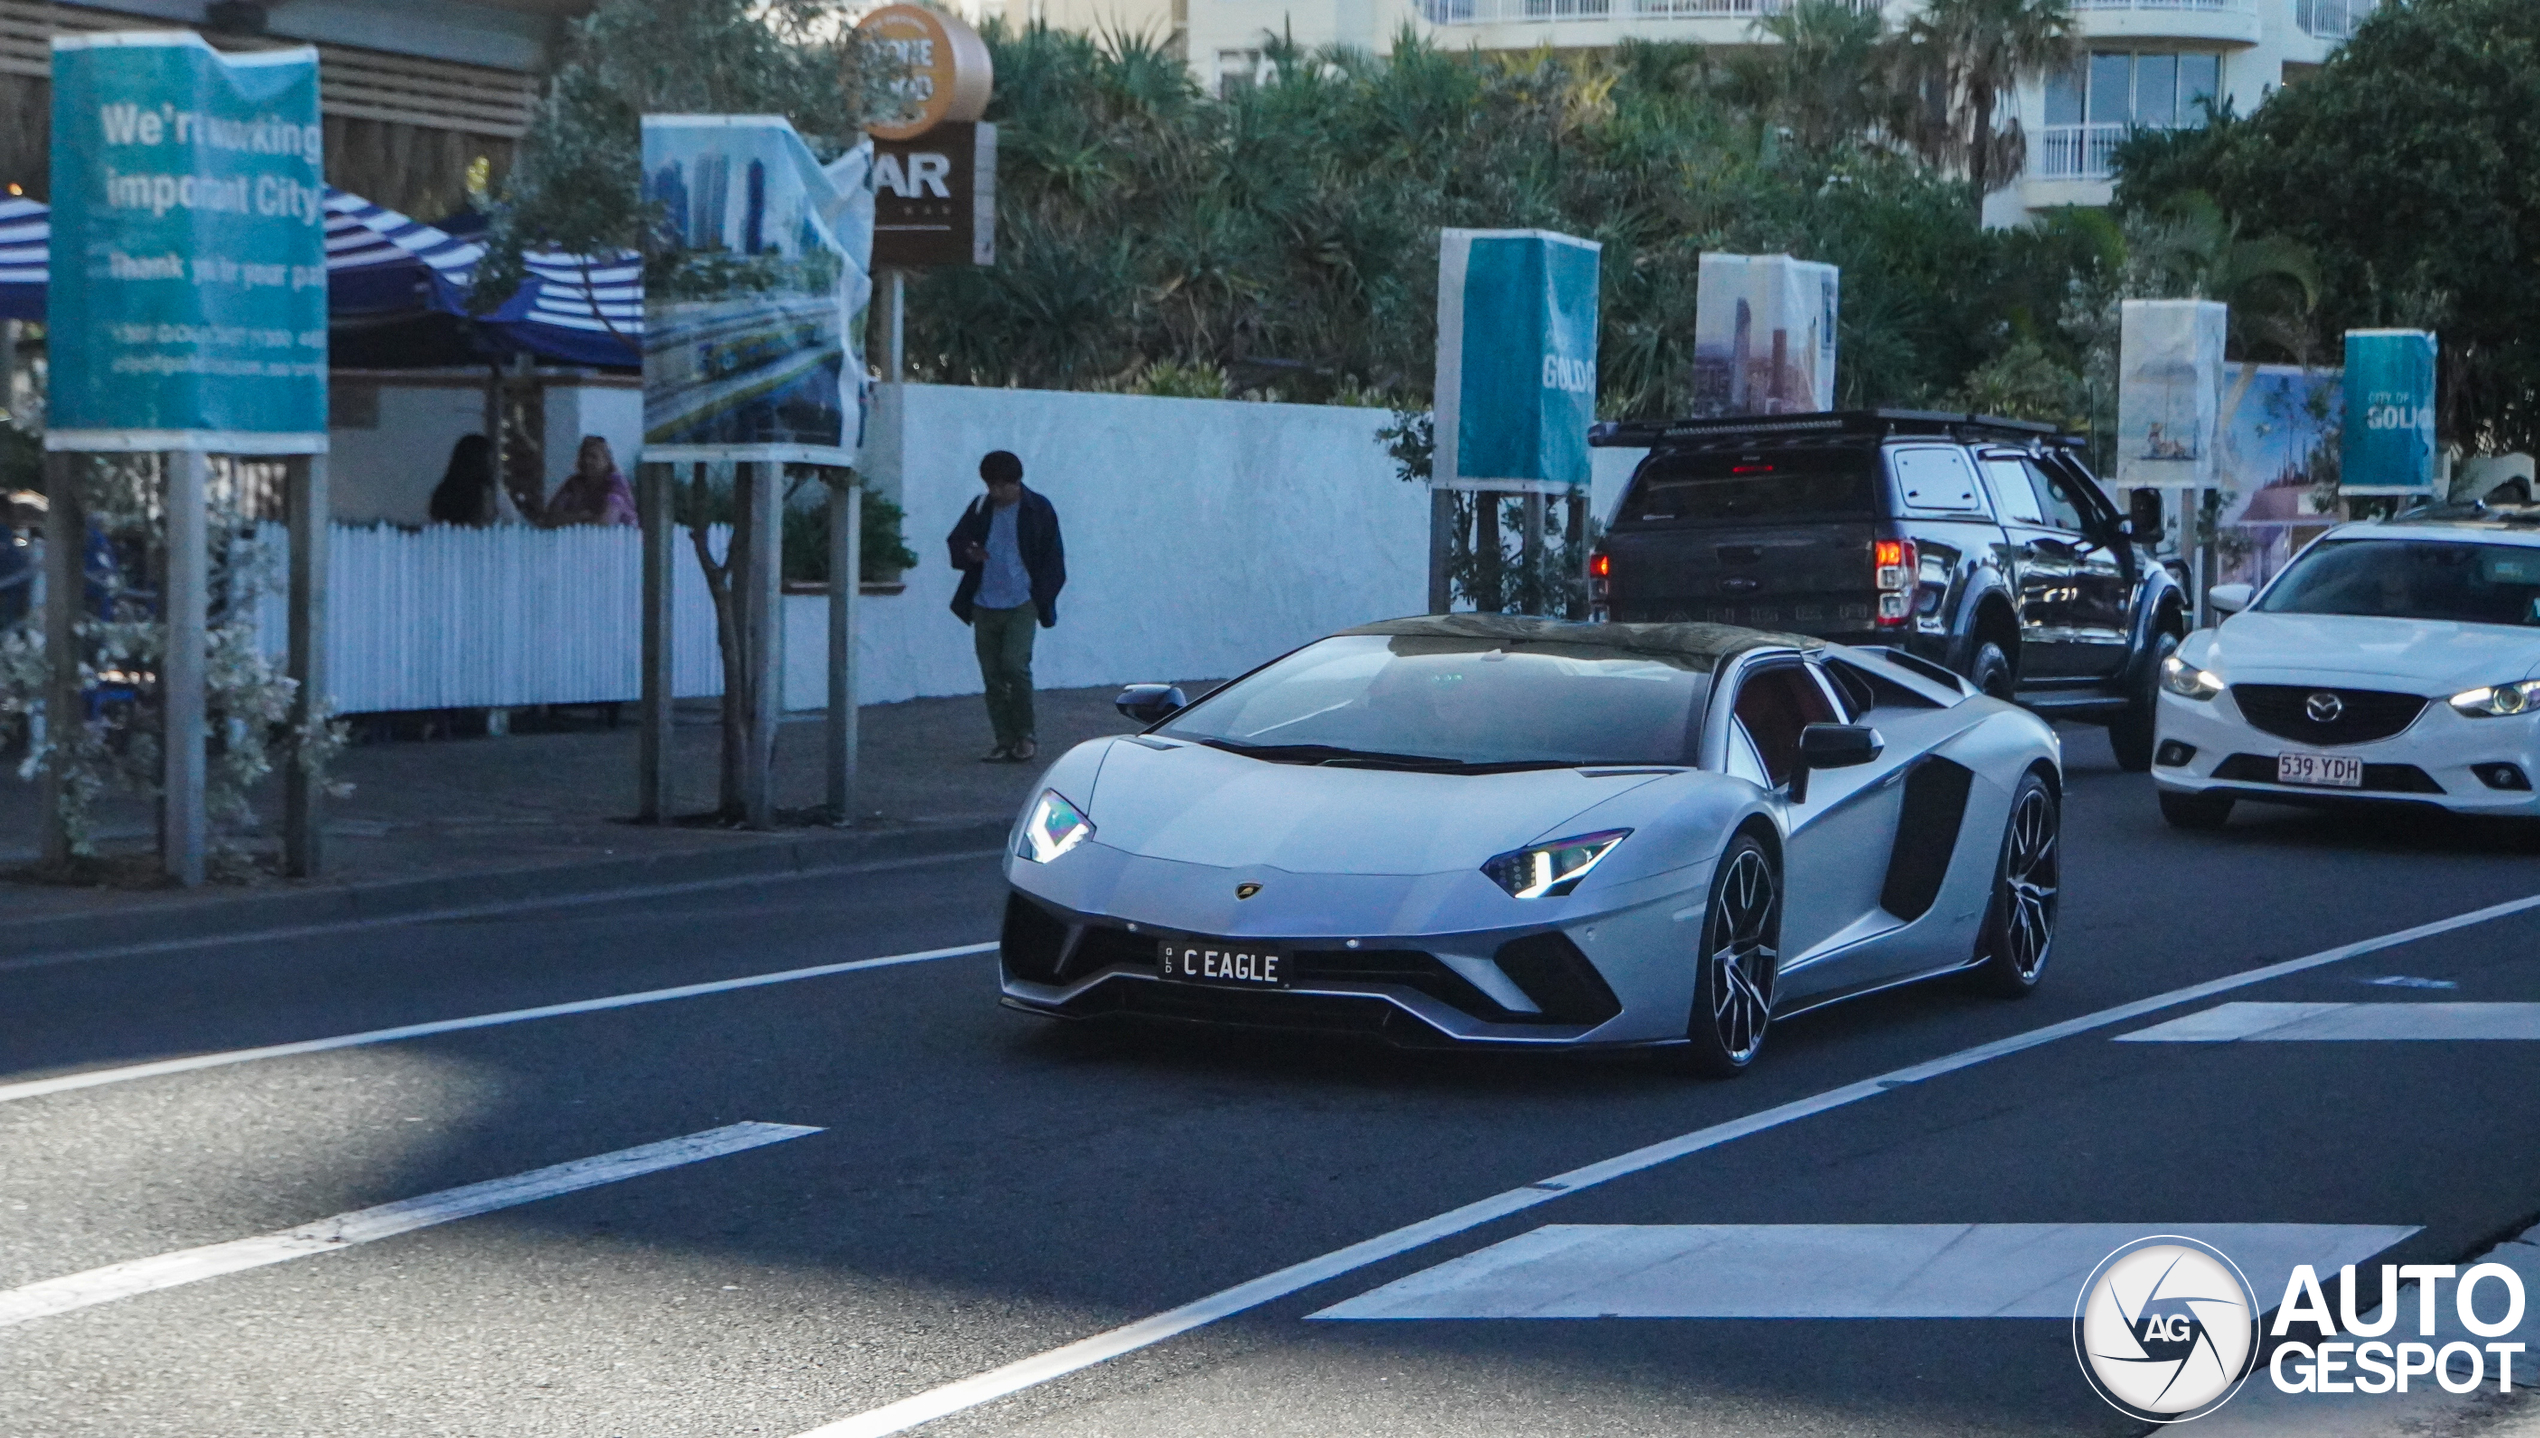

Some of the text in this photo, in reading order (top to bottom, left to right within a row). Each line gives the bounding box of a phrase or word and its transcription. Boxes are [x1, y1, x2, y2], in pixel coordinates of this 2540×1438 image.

[2281, 756, 2359, 780] 539 YDH
[1184, 949, 1279, 983] C EAGLE
